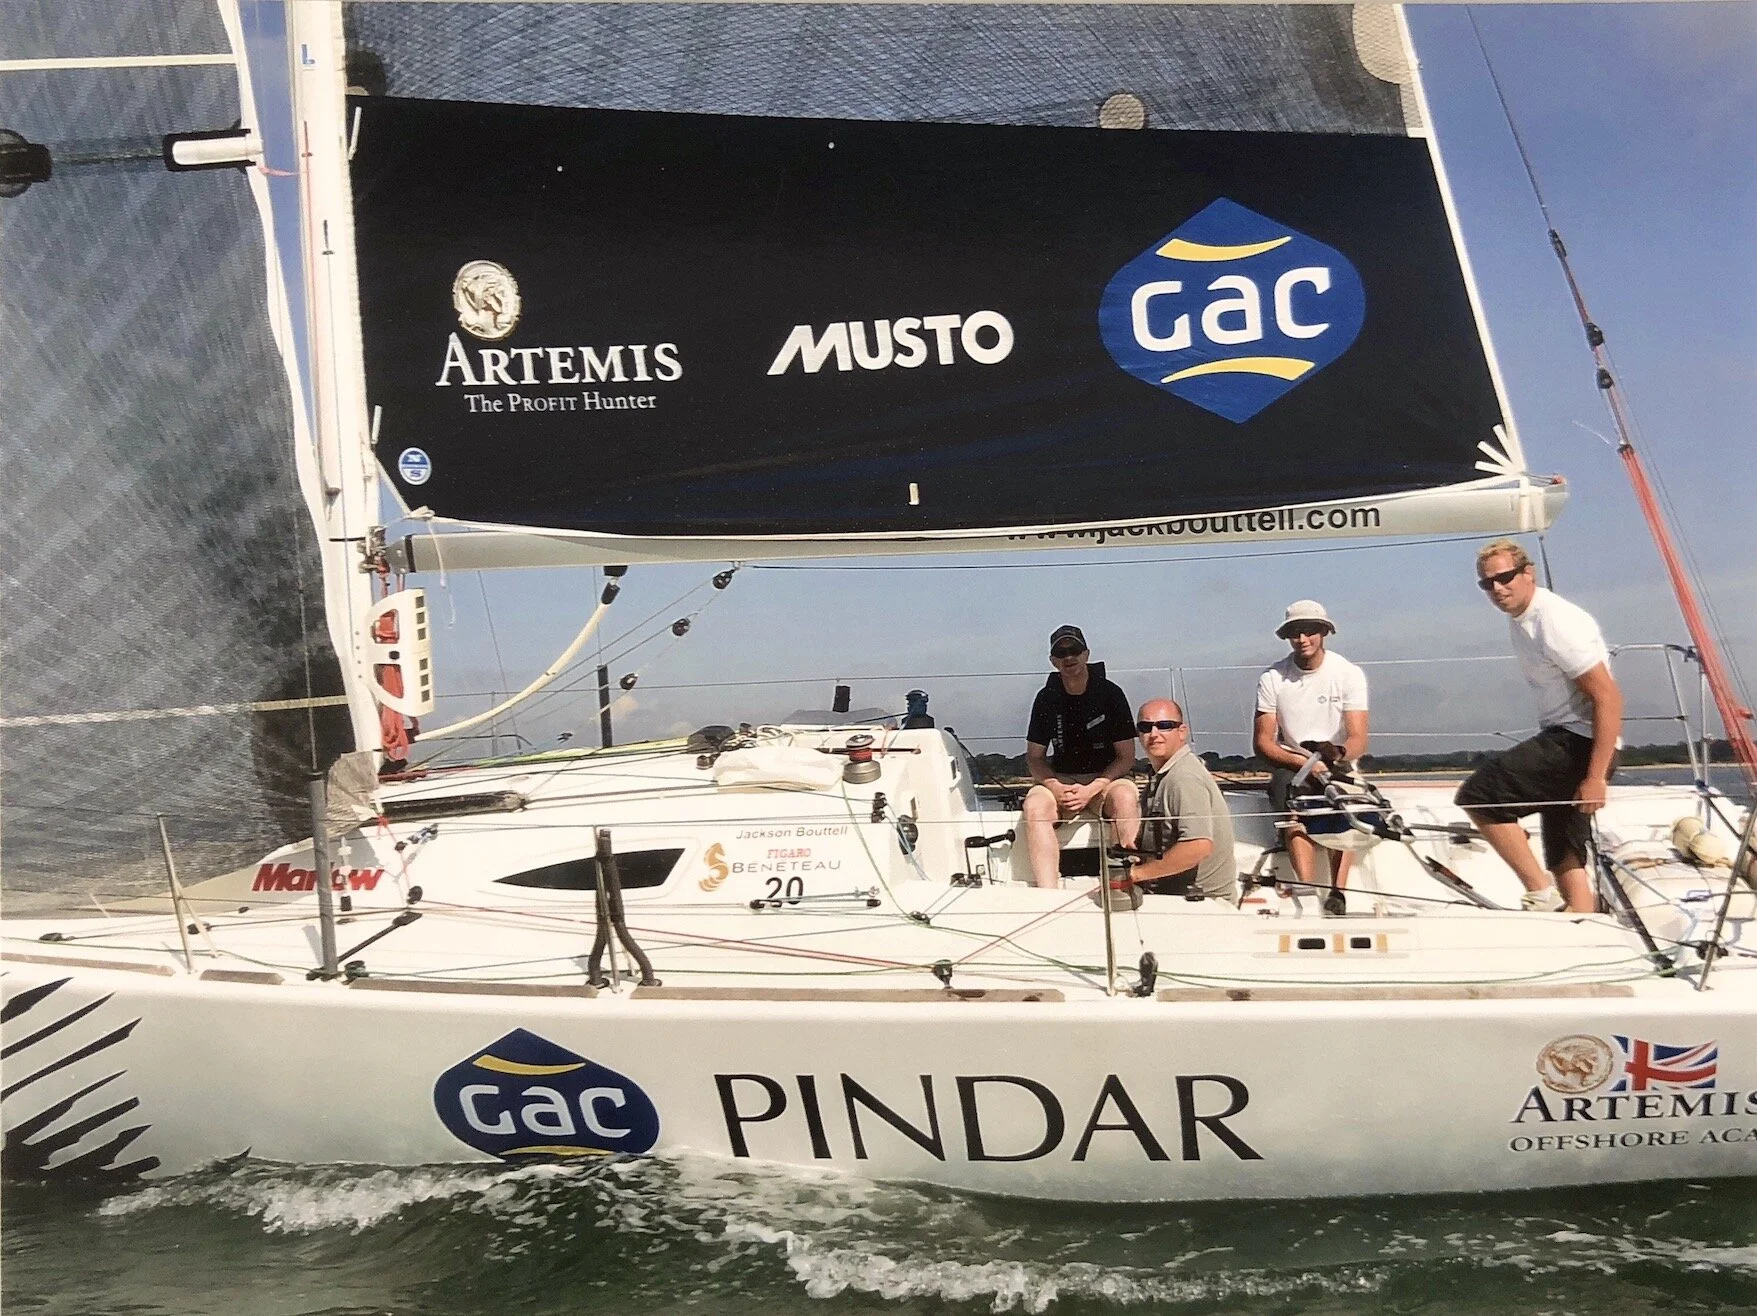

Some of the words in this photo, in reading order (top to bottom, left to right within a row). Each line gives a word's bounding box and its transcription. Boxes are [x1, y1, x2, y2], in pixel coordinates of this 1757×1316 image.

[767, 310, 1014, 376] MUSTO
[435, 332, 683, 386] ARTEMIS
[464, 394, 503, 413] The
[507, 393, 577, 412] PROFIT
[582, 391, 657, 411] Hunter
[1008, 507, 1381, 544] .jackbouttell.com
[736, 829, 791, 839] Jackson
[796, 826, 848, 837] Bouttell
[732, 861, 841, 873] BENETEAU
[767, 848, 812, 859] FIGARO
[252, 862, 384, 891] Marow
[765, 876, 804, 905] 20
[714, 1074, 1264, 1161] PINDAR
[1509, 1130, 1689, 1152] OFFSHORE
